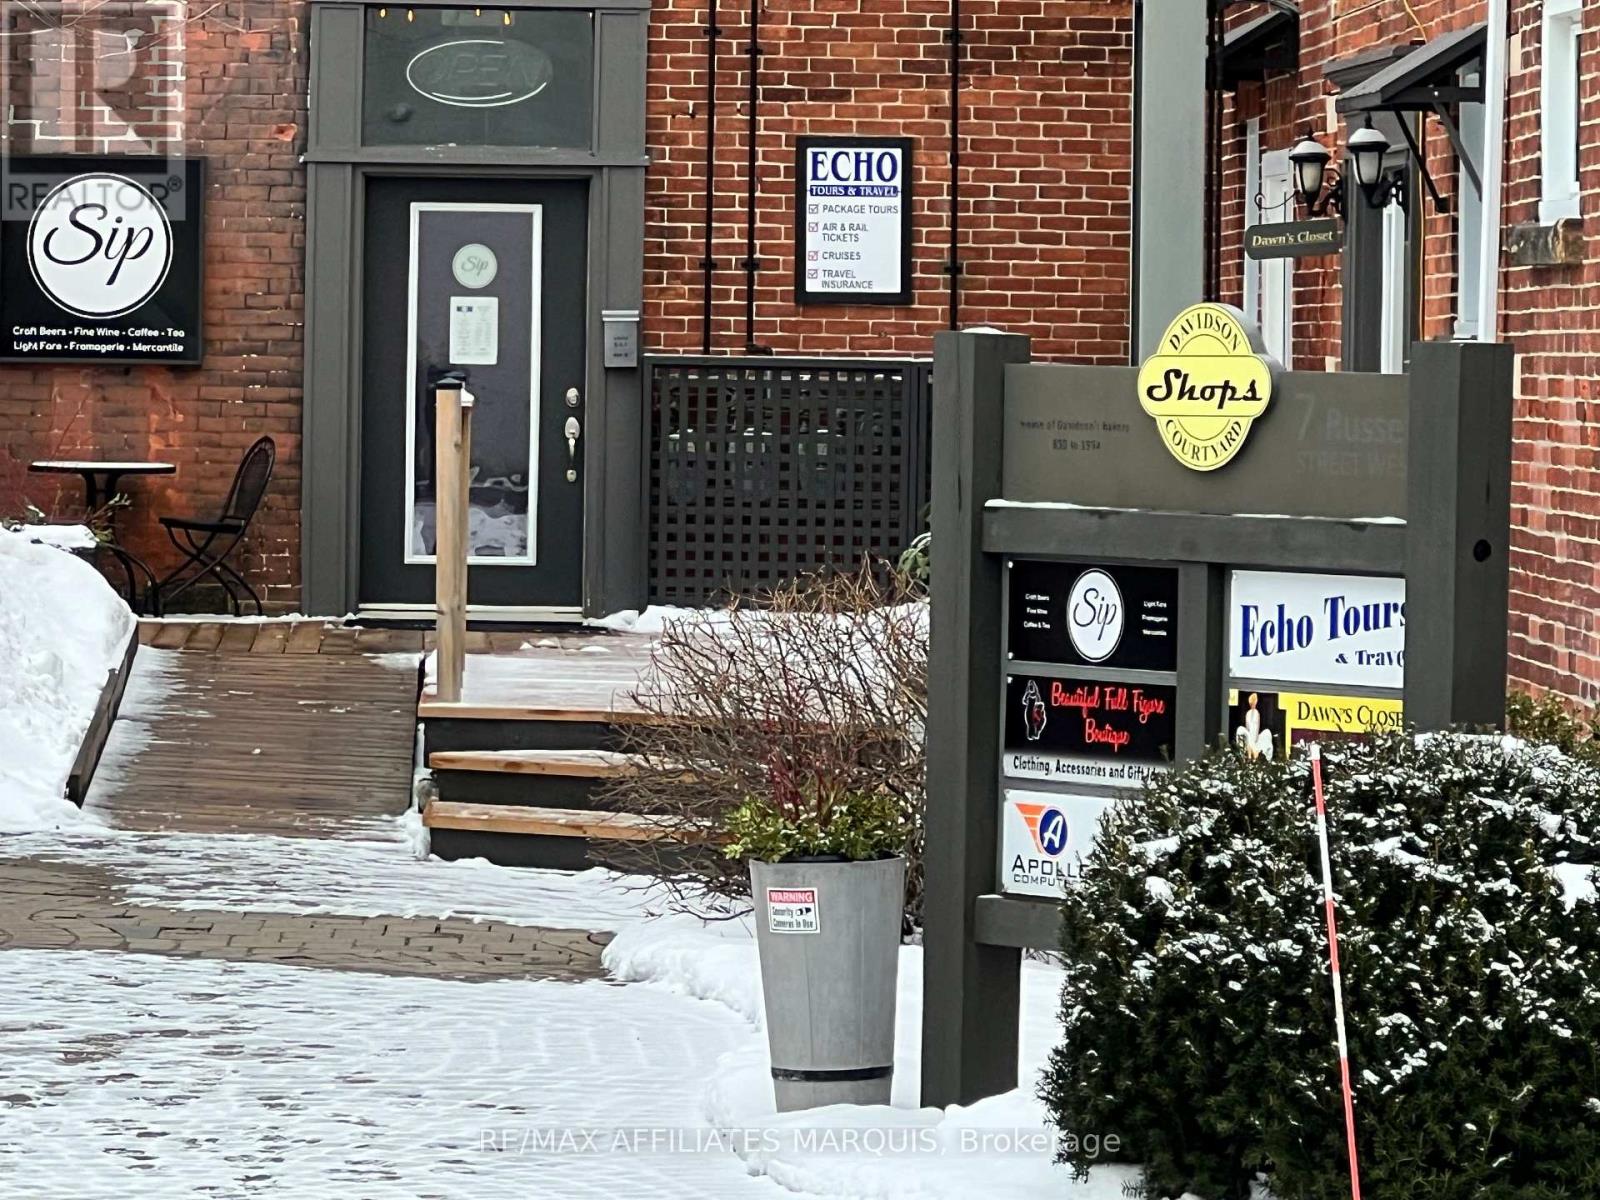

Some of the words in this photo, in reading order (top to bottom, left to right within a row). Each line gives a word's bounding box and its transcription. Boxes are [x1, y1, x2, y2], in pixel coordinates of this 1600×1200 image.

[810, 151, 898, 182] ECHO
[811, 186, 845, 196] TOURS
[847, 187, 857, 196] &
[859, 186, 897, 197] TRAVEL
[822, 204, 866, 214] PACKAGE
[868, 205, 899, 214] TOURS
[822, 223, 837, 232] AIR
[839, 223, 846, 232] &
[848, 223, 868, 232] RAIL
[43, 203, 154, 286] Sip
[822, 233, 860, 242] TICKETS
[1252, 232, 1295, 247] Dawn's
[1297, 230, 1333, 243] Closet
[822, 251, 861, 261] CRUISES
[460, 256, 489, 277] Sip
[822, 269, 857, 279] TRAVEL
[821, 280, 873, 289] INSURANCE
[12, 326, 38, 336] Craft
[39, 326, 67, 336] Beers
[73, 327, 95, 336] Fine
[95, 327, 120, 337] Wine
[127, 328, 160, 337] Coffee
[166, 327, 186, 338] Tea
[1168, 312, 1241, 352] DAVIDSON
[13, 341, 38, 352] Light
[39, 341, 62, 351] Fare
[69, 341, 125, 353] Fromagerie
[132, 342, 184, 353] Mercantile
[1146, 368, 1263, 410] Shops
[1165, 419, 1242, 462] COURTYARD
[1073, 588, 1117, 641] Sip
[1239, 603, 1314, 658] Echo
[1323, 595, 1405, 641] Tours
[1335, 653, 1349, 665] &
[1051, 681, 1100, 718] Beautiful
[1104, 686, 1129, 711] Full
[1132, 689, 1166, 724] Figure
[1297, 701, 1353, 724] DAWN'S
[1085, 718, 1130, 752] Boutique
[1056, 759, 1106, 777] Accessories
[1108, 764, 1125, 779] and
[1127, 765, 1144, 781] Gift
[770, 891, 813, 902] WARNING
